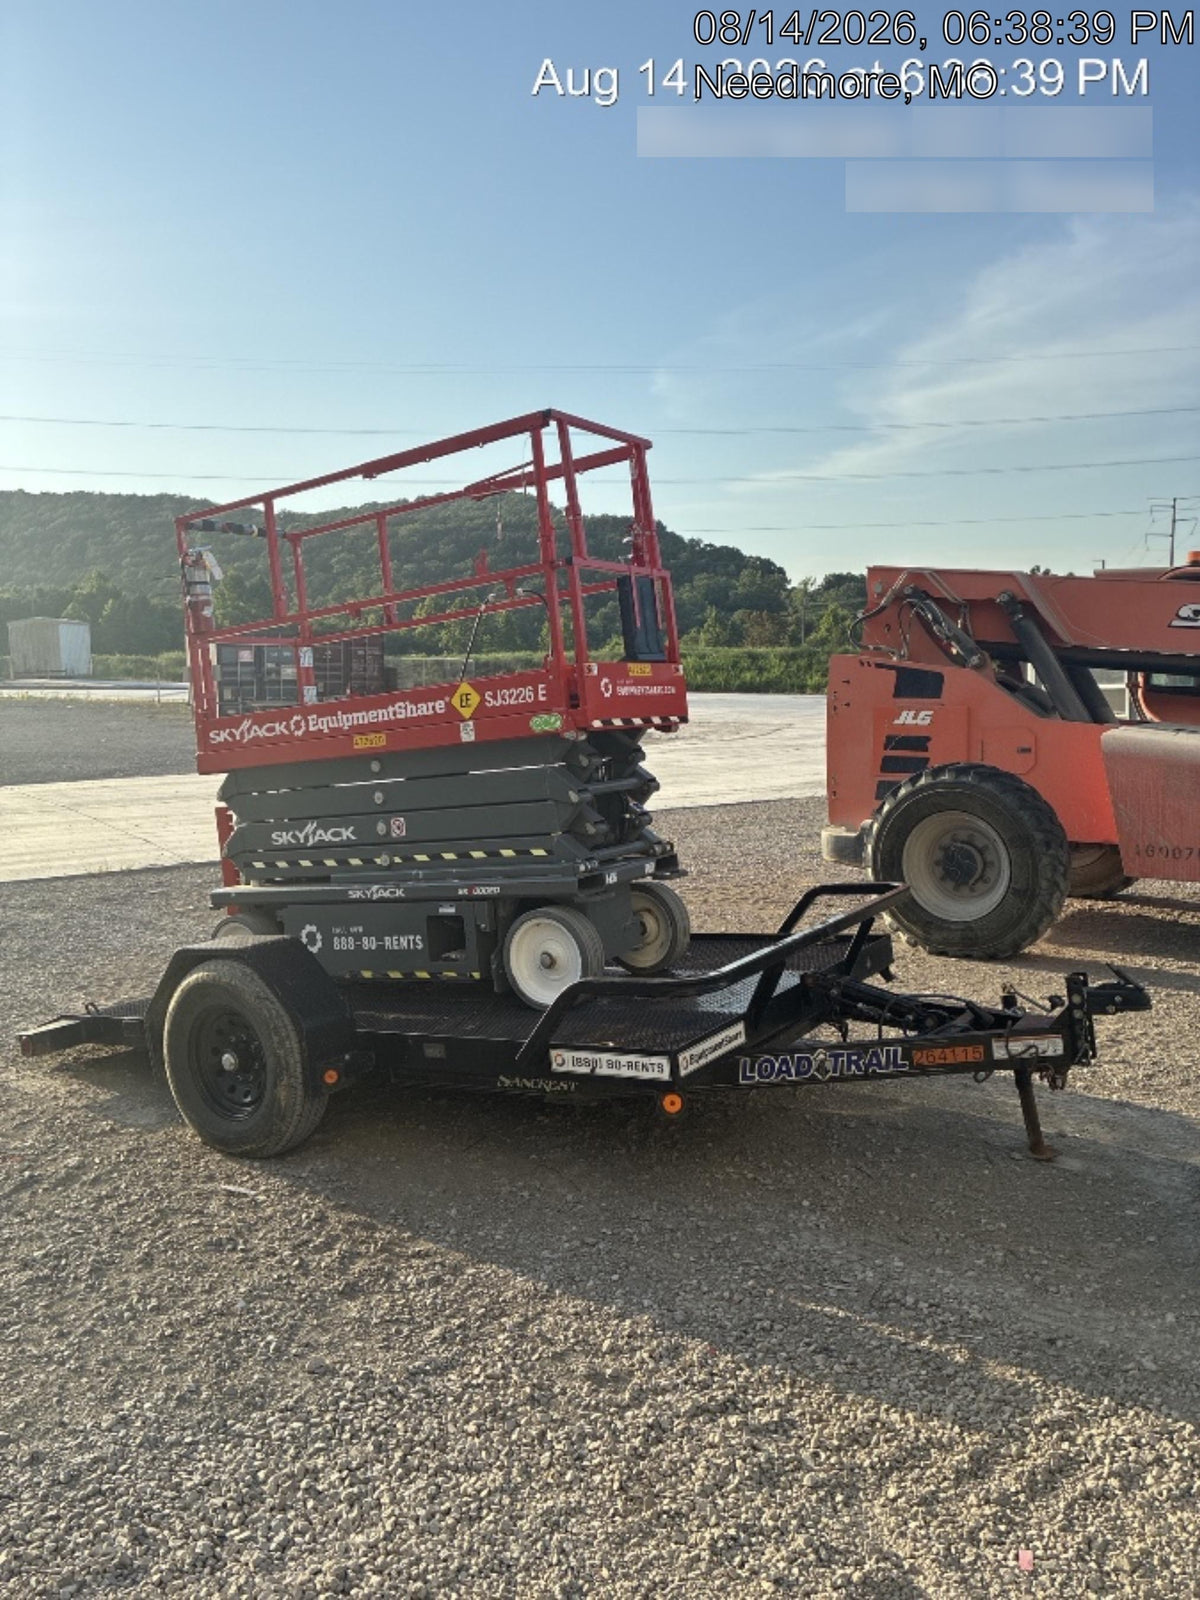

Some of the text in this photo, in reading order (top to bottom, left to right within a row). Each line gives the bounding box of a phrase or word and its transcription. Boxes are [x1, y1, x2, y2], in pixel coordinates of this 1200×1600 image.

[484, 683, 548, 708] SJ3226 E
[307, 699, 446, 733] EquipmentShare
[893, 710, 935, 726] JLG
[209, 718, 291, 744] SKYJACK
[271, 820, 358, 847] SKYJACK
[348, 884, 405, 900] SKYJACK
[333, 934, 424, 951] 888-80-RENTS
[739, 1046, 909, 1084] LOAD TRAIL
